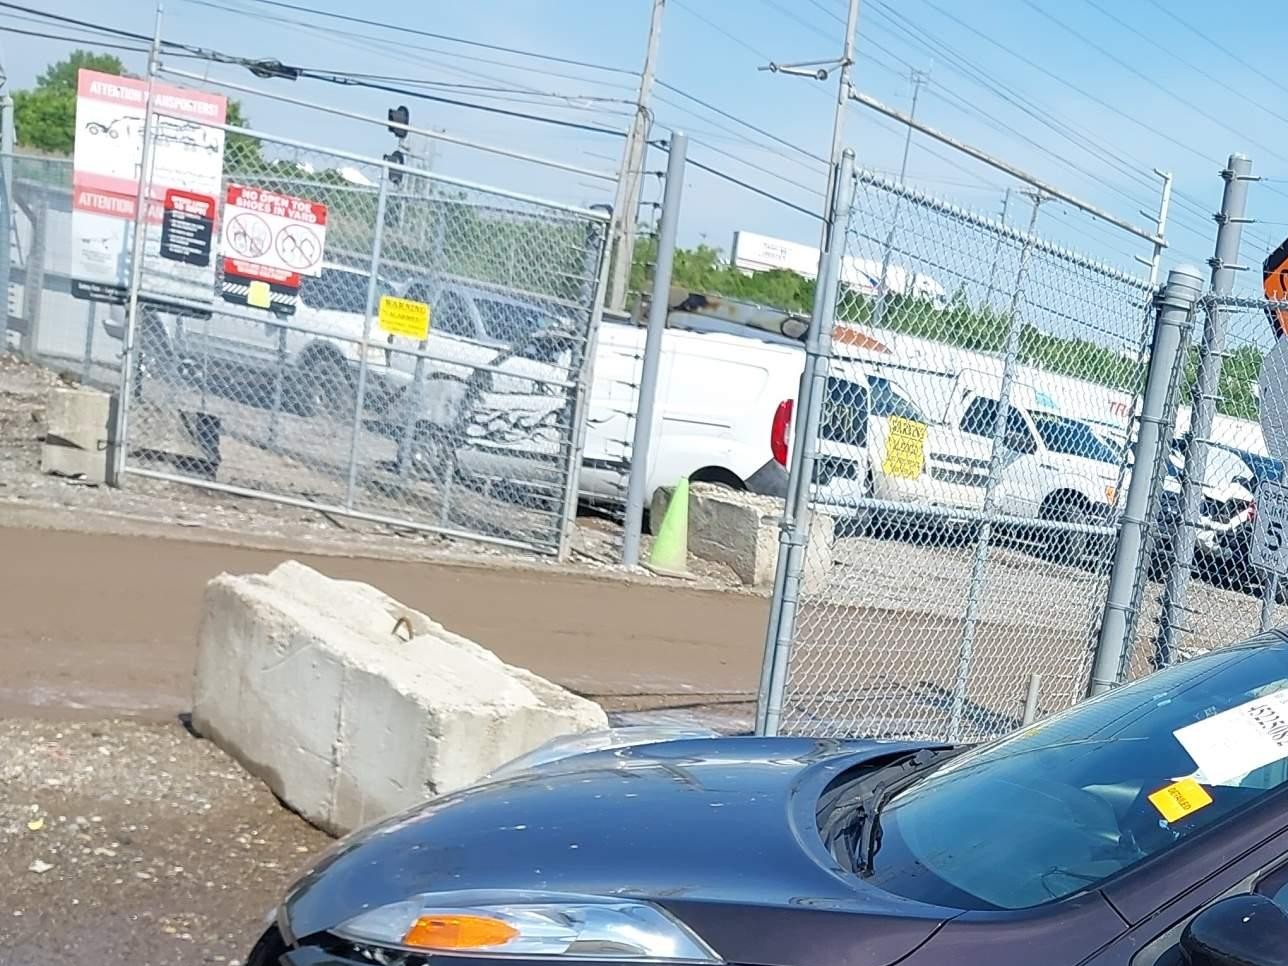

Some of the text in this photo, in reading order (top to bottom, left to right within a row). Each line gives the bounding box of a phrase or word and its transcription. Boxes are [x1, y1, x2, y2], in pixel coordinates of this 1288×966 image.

[89, 80, 143, 102] ATTENTION
[79, 191, 135, 213] ATTENTION
[235, 197, 317, 223] SHOES IN YARD
[240, 189, 312, 213] NO OPEN TOE
[1265, 521, 1283, 551] 5
[1262, 551, 1280, 565] MPH
[1168, 787, 1192, 811] DETAILED
